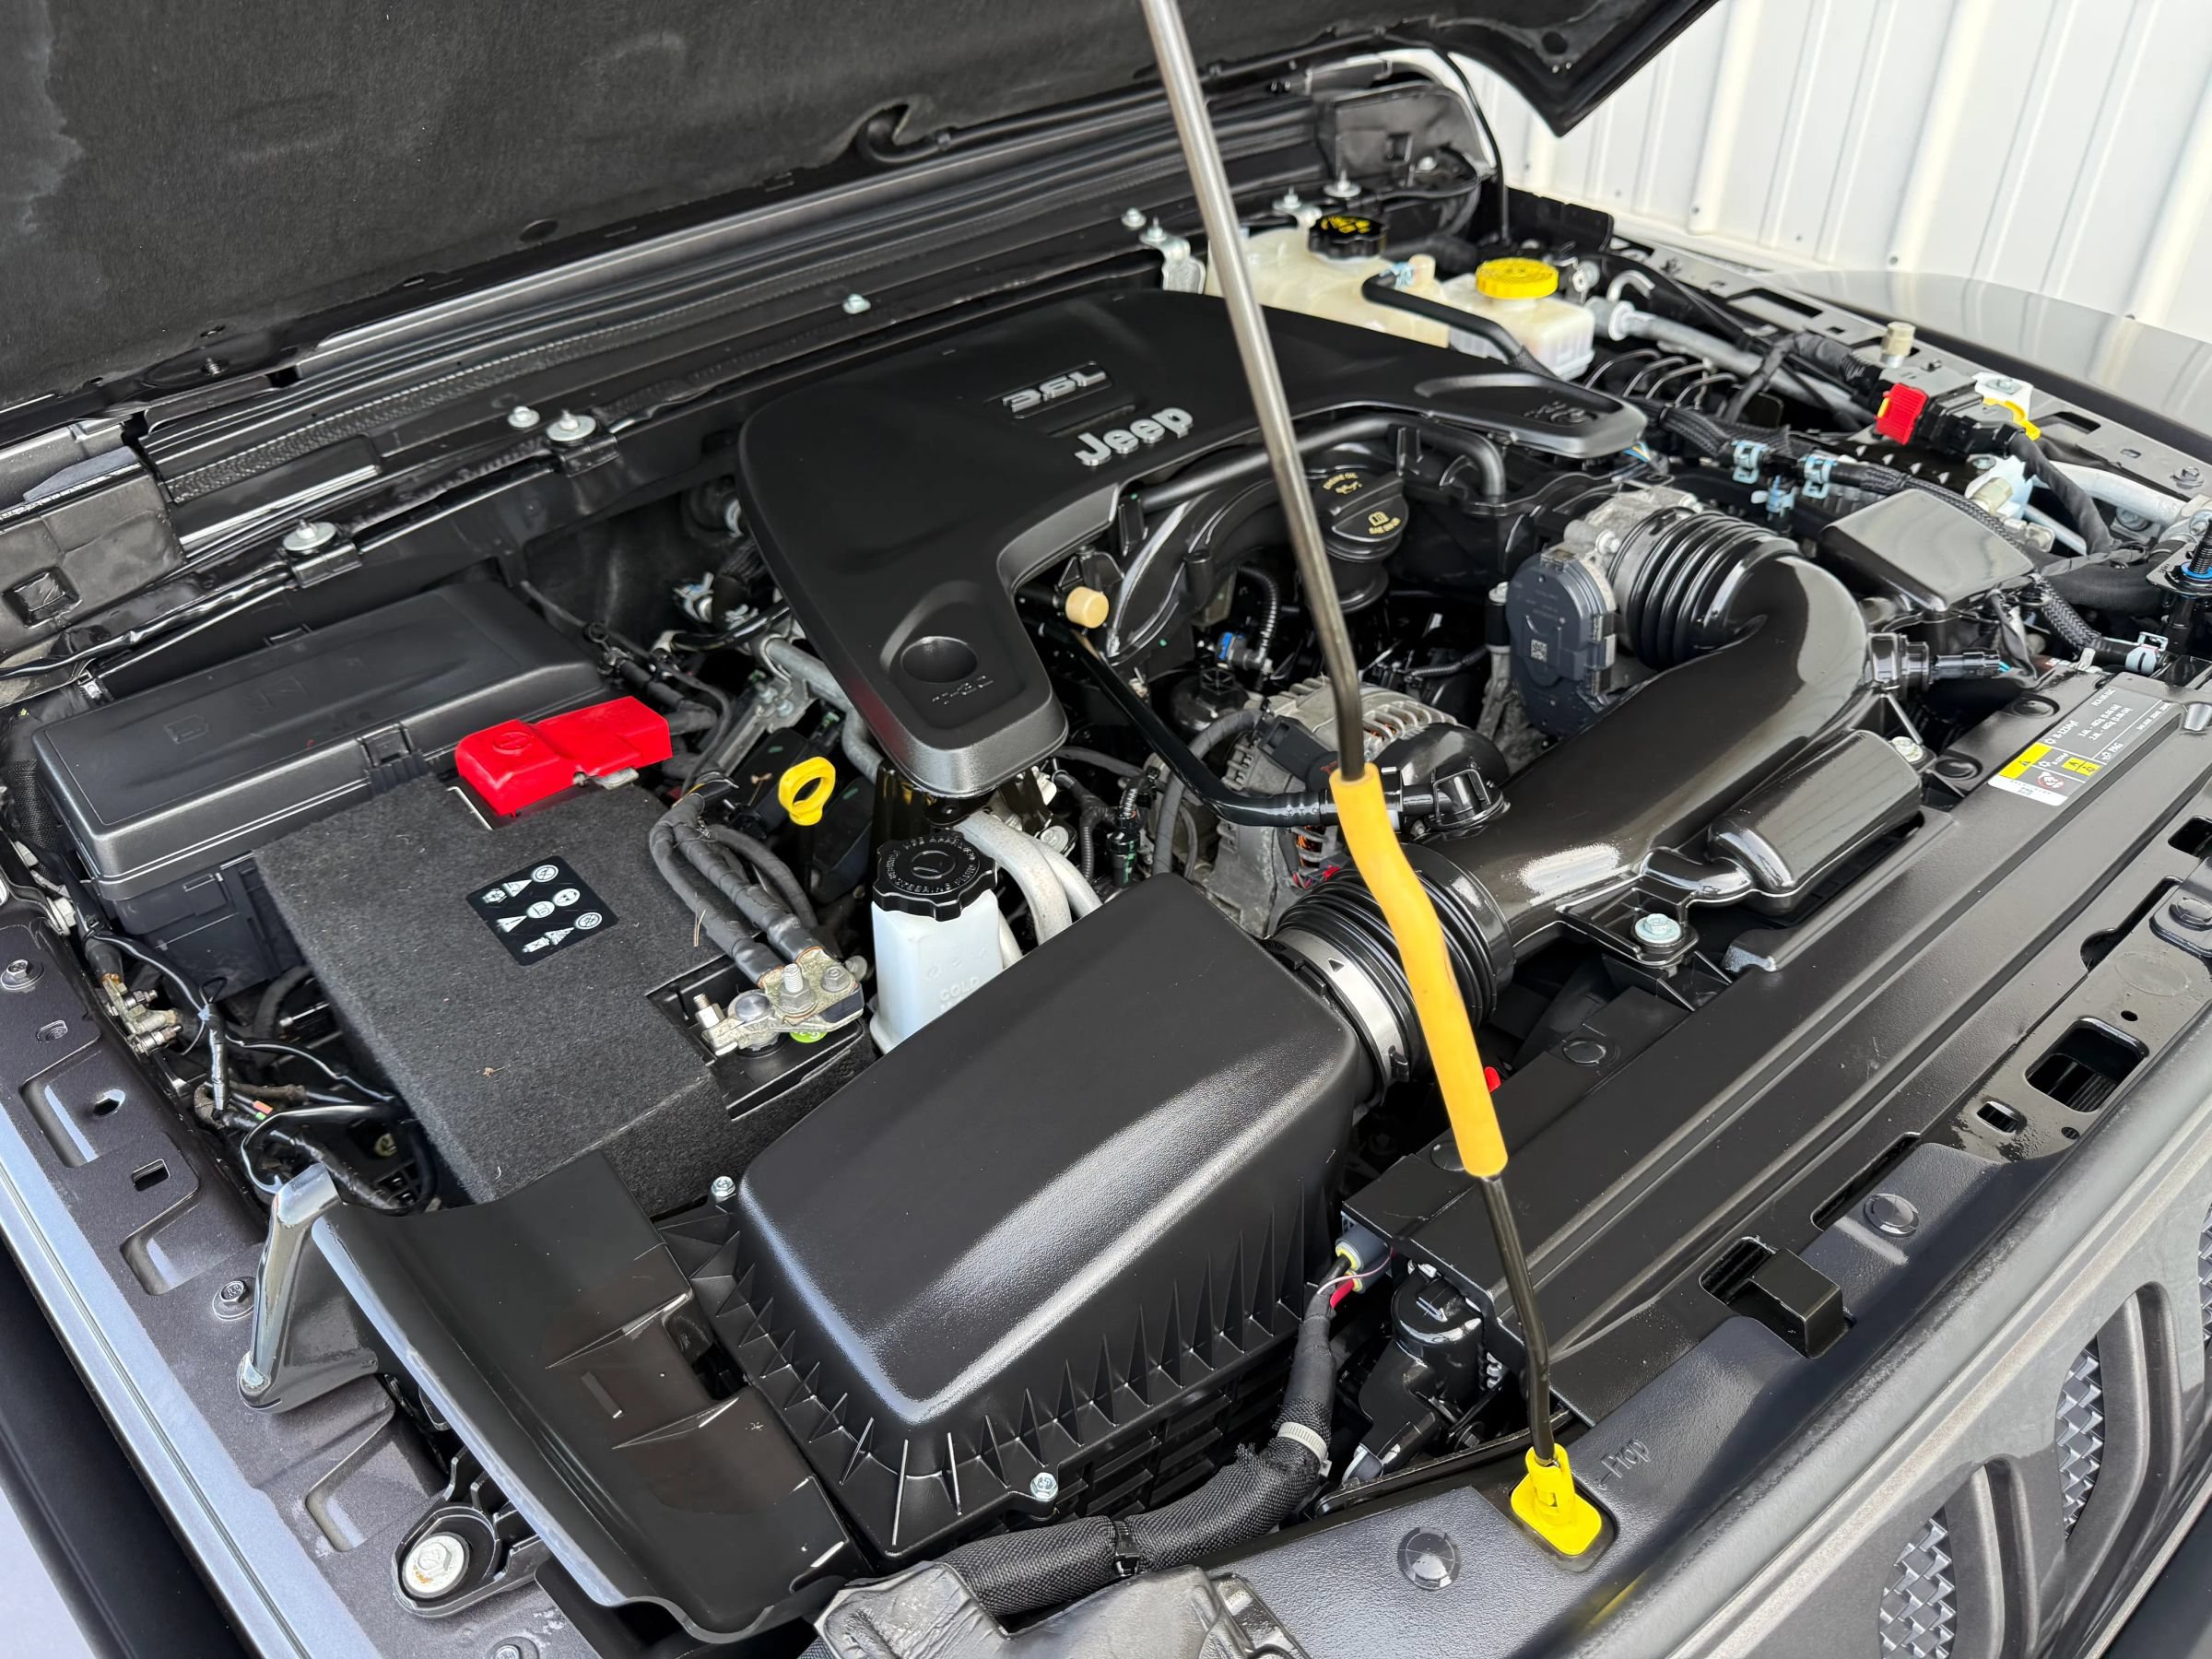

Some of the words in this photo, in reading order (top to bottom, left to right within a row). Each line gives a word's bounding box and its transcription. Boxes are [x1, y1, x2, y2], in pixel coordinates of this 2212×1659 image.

[1074, 406, 1194, 467] Jeep
[1323, 473, 1346, 490] ENGINE
[1345, 471, 1358, 479] OIL
[2108, 743, 2124, 753] PAG
[940, 976, 981, 1001] COLD
[1601, 1439, 1652, 1478] Prop
